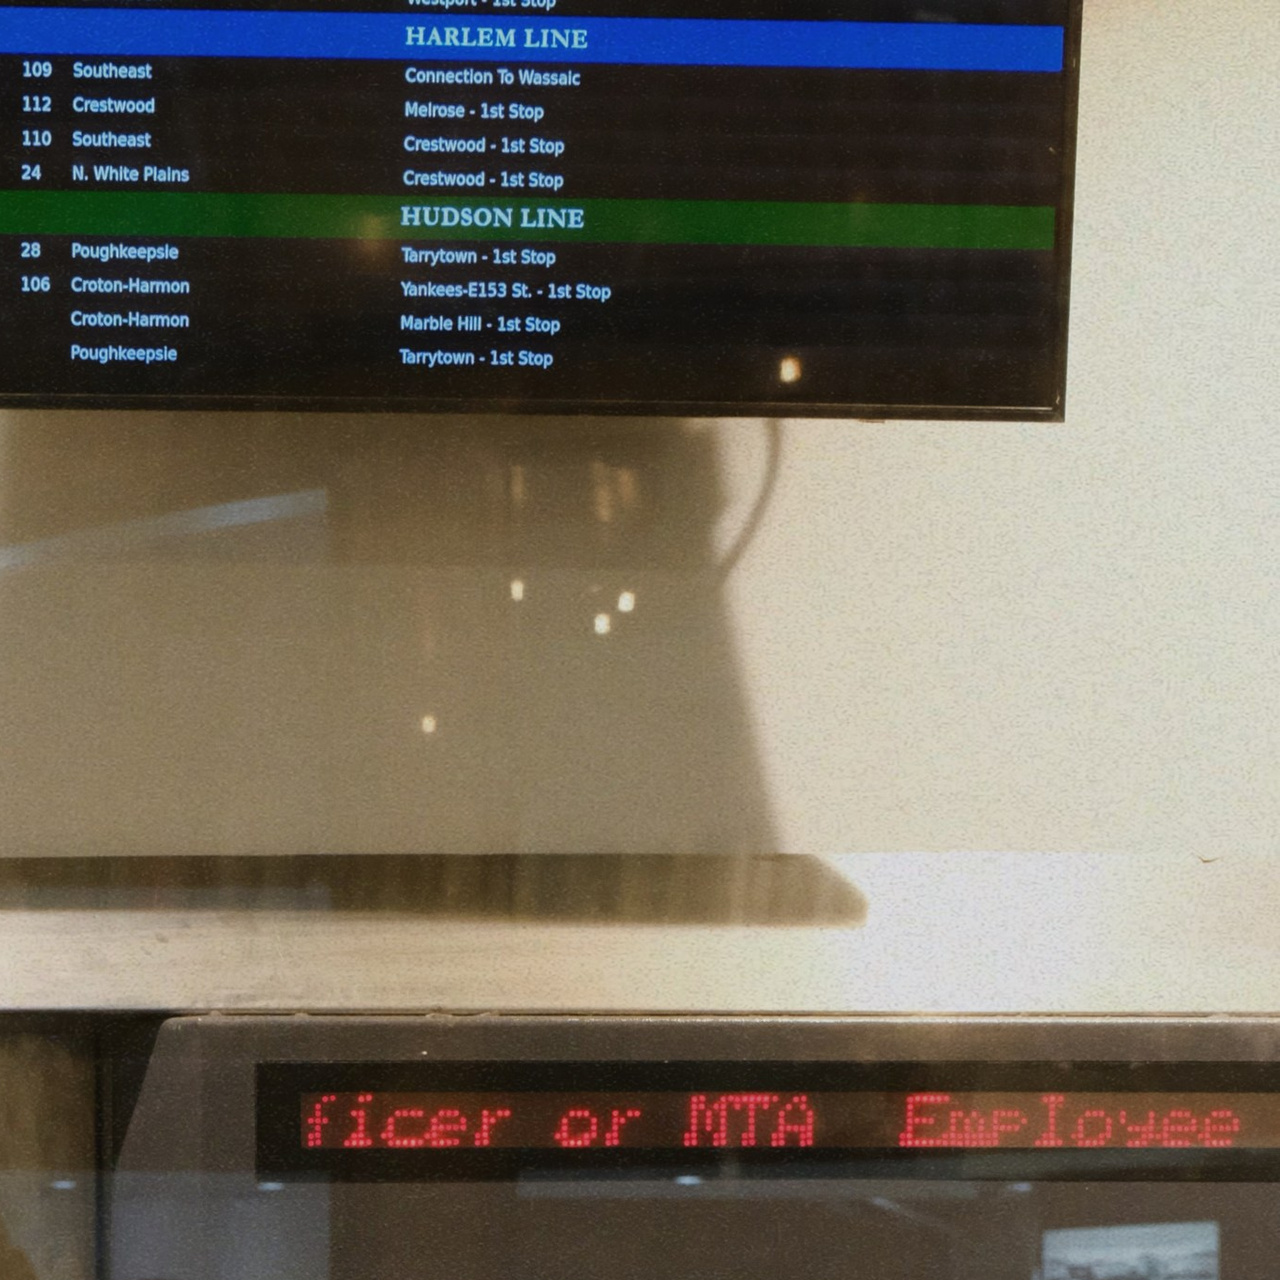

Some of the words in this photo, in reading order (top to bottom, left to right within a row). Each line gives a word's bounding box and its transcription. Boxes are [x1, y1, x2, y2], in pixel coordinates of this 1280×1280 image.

[404, 27, 516, 47] HARLEM
[524, 27, 587, 48] LINE
[23, 61, 52, 77] 109
[73, 62, 152, 78] Southeast
[405, 67, 493, 84] Connection
[497, 68, 514, 84] To
[519, 69, 580, 85] Wassaic
[23, 96, 51, 112] 112
[73, 96, 155, 113] Crestwood
[405, 101, 465, 118] Melrose
[481, 103, 504, 118] 1st
[509, 103, 544, 122] Stop
[23, 130, 51, 146] 110
[73, 131, 151, 147] Southeast
[404, 136, 485, 152] Crestwood
[502, 137, 525, 153] 1st
[530, 138, 564, 156] Stop
[22, 164, 41, 180] 24
[73, 165, 88, 180] N.
[94, 166, 139, 181] White
[144, 166, 189, 182] Plains
[403, 170, 485, 186] Crestwood
[501, 171, 524, 187] 1st
[529, 172, 563, 190] Stop
[401, 207, 512, 227] HUDSON
[521, 208, 584, 228] LINE
[21, 242, 40, 257] 28
[72, 243, 179, 262] Poughkeepsie
[401, 247, 477, 266] Tarrytown
[493, 249, 517, 264] 1st
[521, 249, 556, 267] Stop
[22, 276, 50, 291] 106
[71, 277, 189, 293] Croton-Harmon
[401, 281, 506, 297] Yankees-E153
[512, 283, 532, 298] St.
[549, 283, 571, 298] 1st
[576, 284, 611, 302] Stop
[71, 311, 189, 327] Croton-Harmon
[401, 315, 453, 330] Marble
[458, 316, 481, 331] Hill
[498, 316, 521, 331] 1st
[525, 317, 560, 335] Stop
[71, 345, 177, 364] Poughkeepsie
[399, 349, 474, 367] Tarrytown
[491, 350, 514, 365] 1st
[518, 350, 553, 369] Stop
[554, 1109, 641, 1147] or
[683, 1094, 814, 1147] MTA
